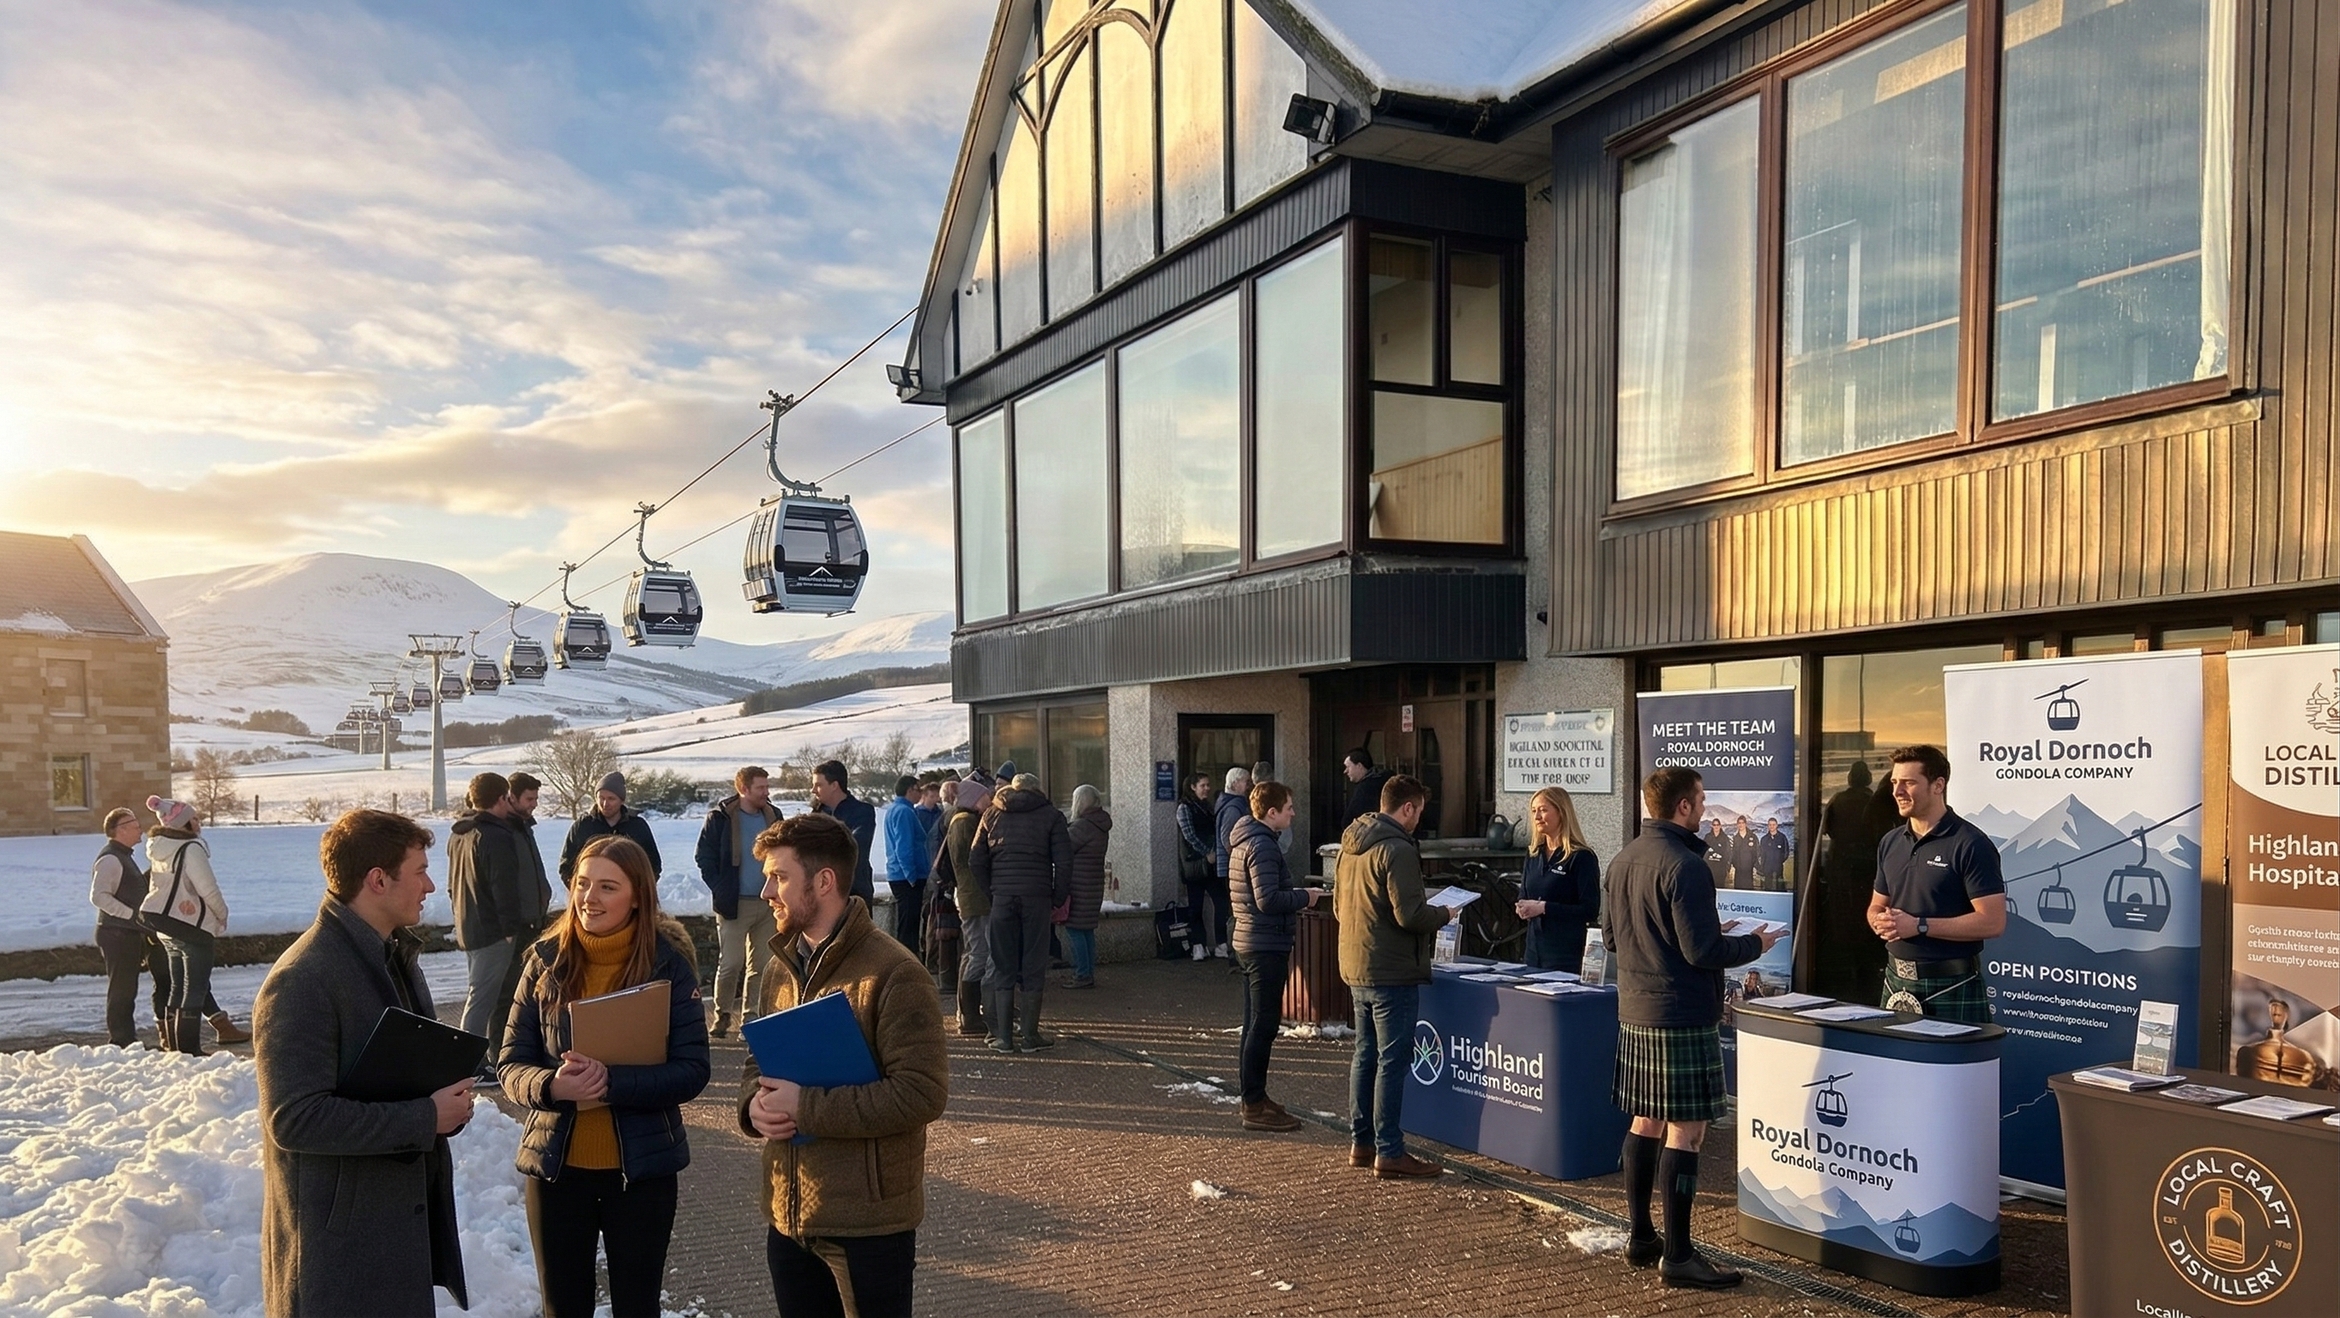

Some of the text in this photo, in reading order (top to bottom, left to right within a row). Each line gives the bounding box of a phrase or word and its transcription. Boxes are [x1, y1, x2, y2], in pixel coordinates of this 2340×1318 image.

[1652, 719, 1776, 737] MEET THE TEAM
[1655, 755, 1774, 768] GONDOLA COMPANY
[1667, 741, 1703, 753] ROYAL
[1705, 740, 1765, 753] DORNOCH
[1979, 736, 2152, 766] Royal Dornoch
[2265, 745, 2337, 761] LOCAL
[1996, 767, 2134, 780] GONDOLA COMPANY
[1988, 961, 2138, 991] OPEN POSITIONS
[1450, 1035, 1543, 1079] Highland
[1450, 1064, 1500, 1090] Tourism
[1503, 1076, 1543, 1100] Board
[1752, 1118, 1919, 1174] Royal Dornoch
[1771, 1149, 1894, 1191] Gondola Company
[2163, 1157, 2292, 1230] LOCAL CRAFT
[2169, 1238, 2283, 1296] DISTILLERY
